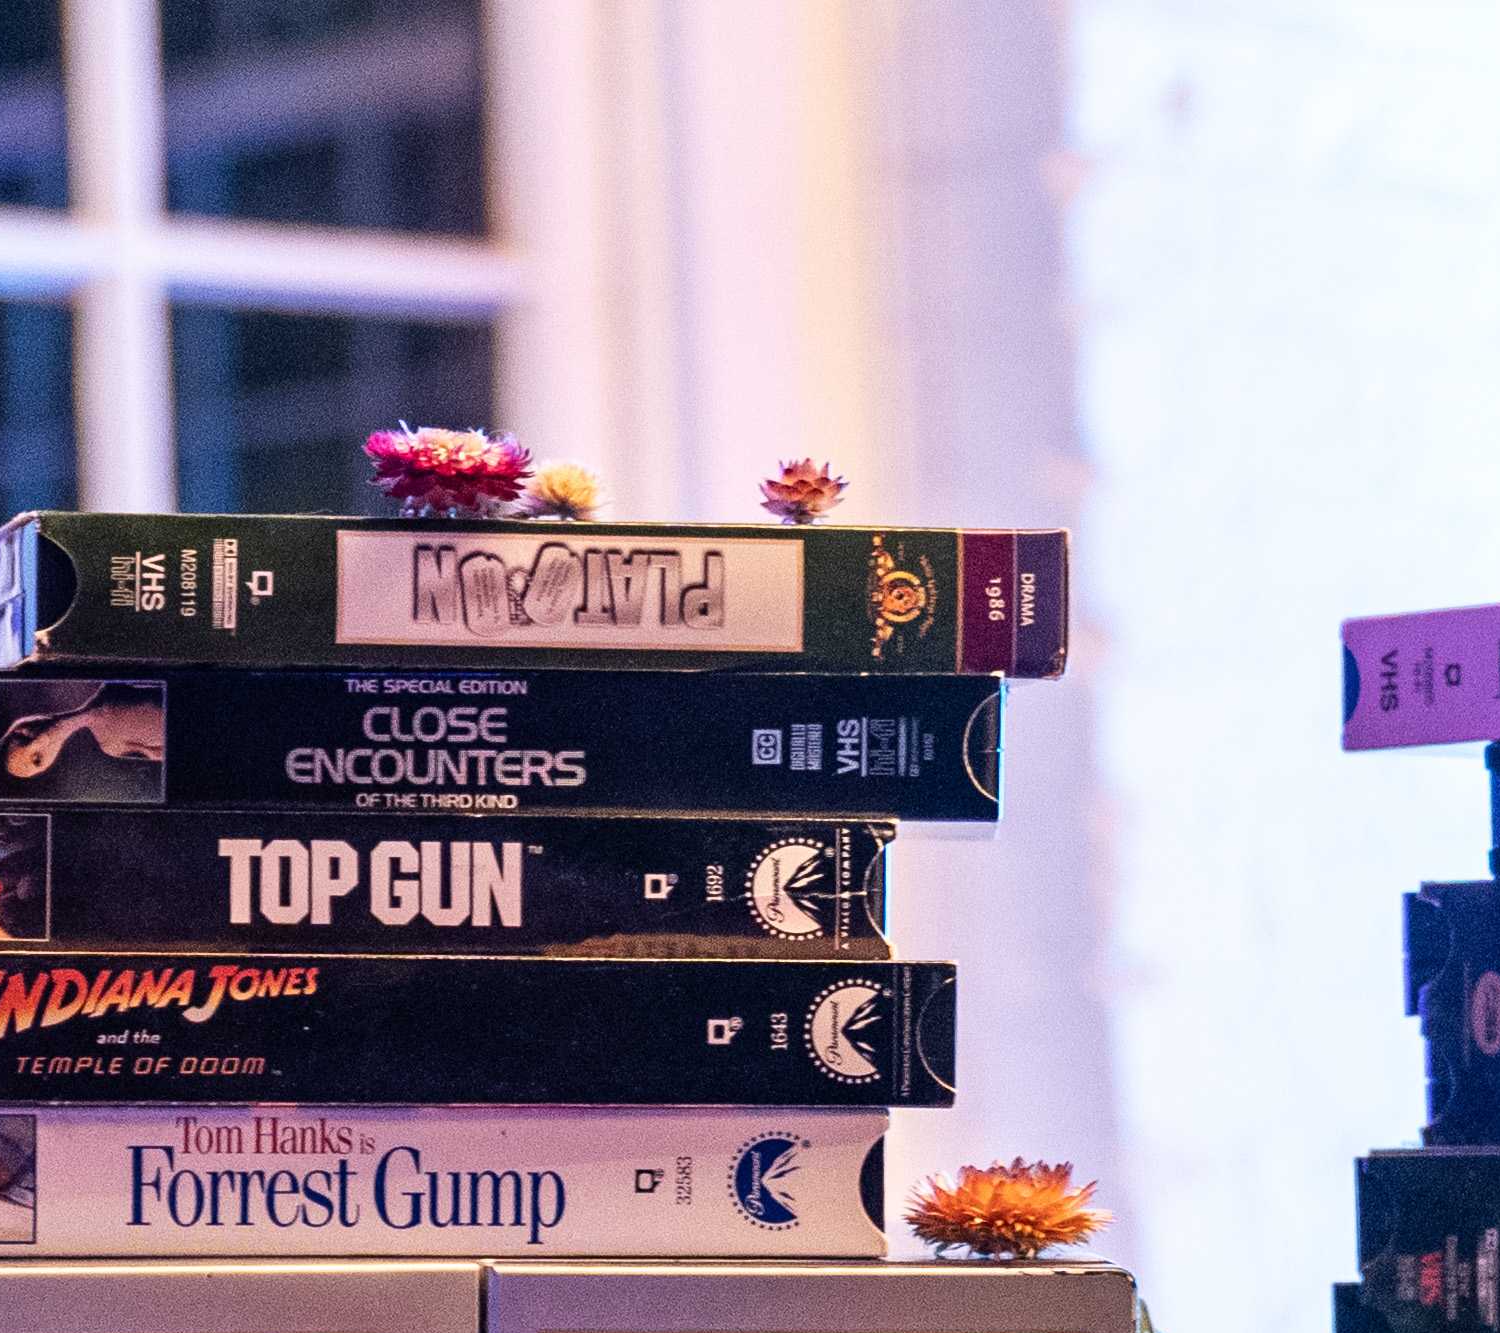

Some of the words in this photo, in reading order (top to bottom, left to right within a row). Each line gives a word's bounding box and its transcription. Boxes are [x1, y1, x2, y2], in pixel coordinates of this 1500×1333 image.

[141, 553, 167, 613] VHS
[180, 548, 198, 618] M208119
[988, 576, 1005, 622] 1986
[1019, 572, 1035, 627] DRAMA
[343, 679, 378, 695] THE
[382, 680, 454, 695] SPECIAL
[458, 681, 528, 695] EDITION
[1379, 648, 1400, 712] VHS
[362, 706, 507, 744] CLOSE
[836, 719, 860, 775] VHS
[285, 749, 586, 786] ENCOUNTERS
[355, 793, 381, 808] OF
[382, 794, 419, 808] THE
[421, 794, 472, 809] THIRD
[475, 794, 518, 809] KIND
[218, 838, 358, 927] TOP
[369, 840, 522, 928] GUN
[705, 864, 724, 903] 1692
[766, 857, 784, 923] Paramount
[183, 963, 319, 1023] JONES
[96, 1031, 128, 1045] and
[131, 1030, 161, 1045] the
[770, 1012, 789, 1052] 1643
[825, 1000, 841, 1067] Paramount
[16, 1057, 124, 1075] TEMPLE
[134, 1057, 173, 1074] OF
[178, 1056, 267, 1075] DOOM
[174, 1116, 243, 1155] Tom
[254, 1116, 353, 1155] Hanks
[359, 1132, 377, 1155] is
[125, 1144, 361, 1229] Forrest
[376, 1145, 566, 1245] Gump
[675, 1154, 692, 1206] 32583
[746, 1150, 764, 1214] Paramount
